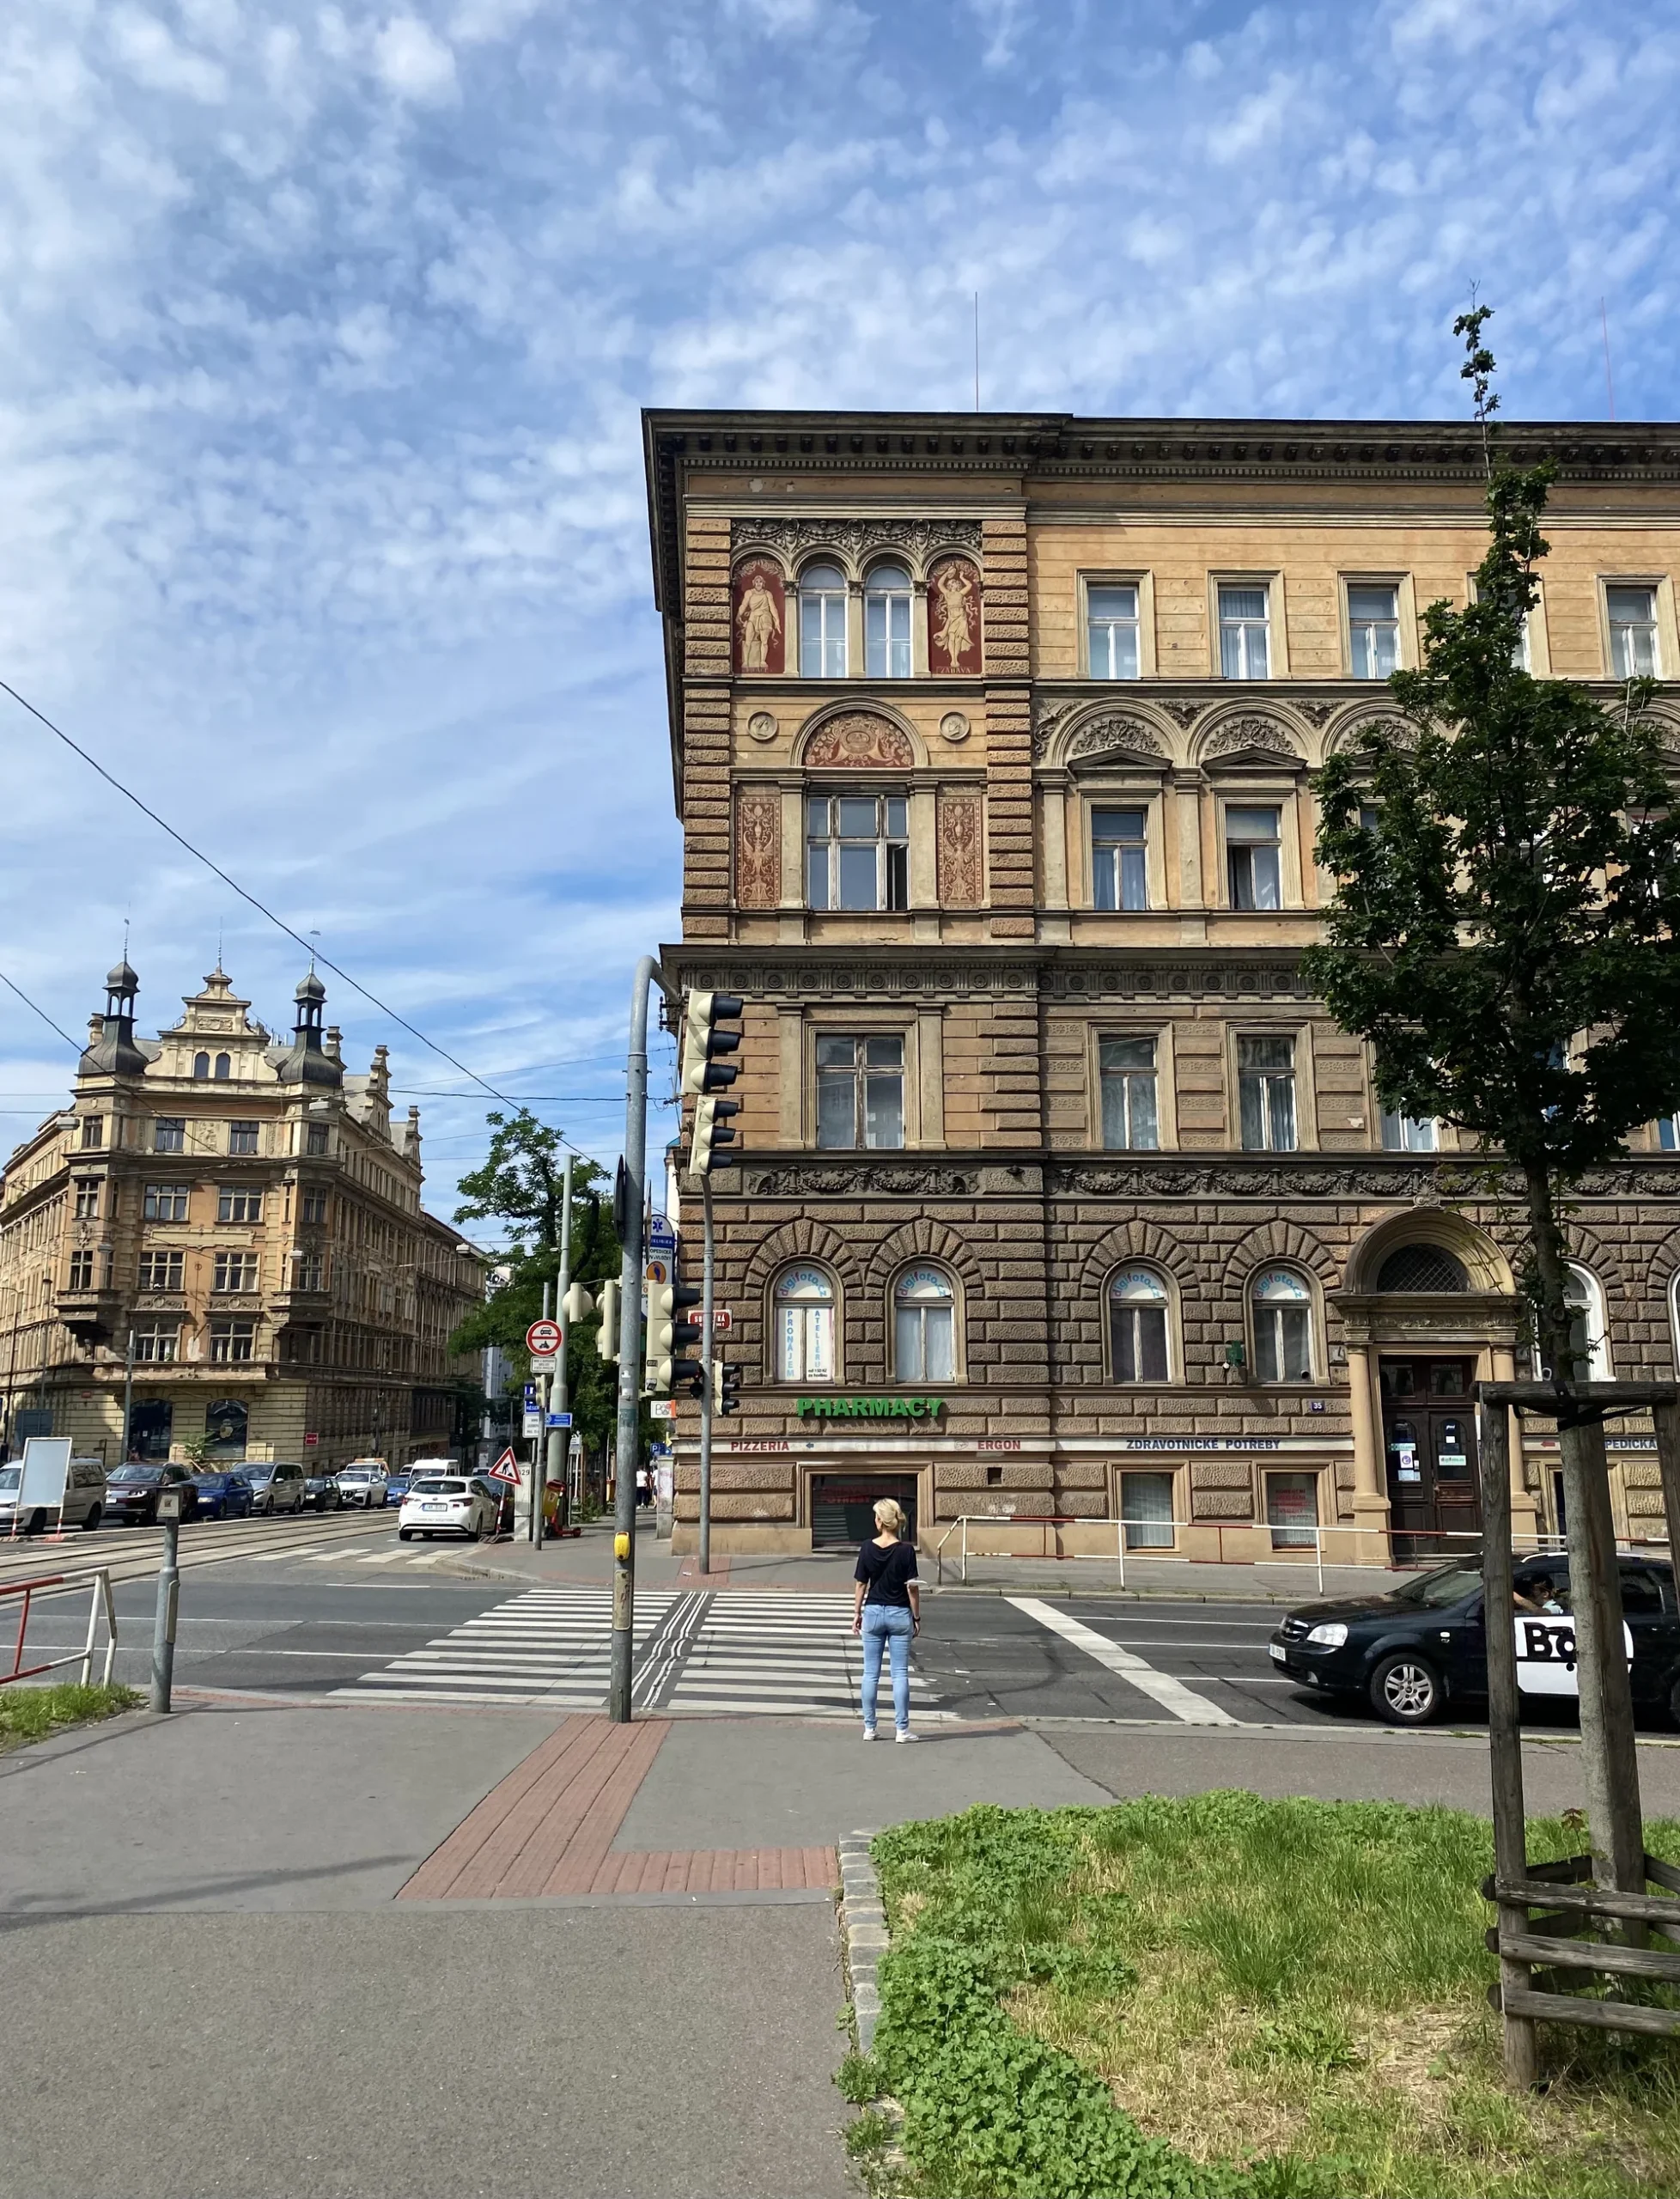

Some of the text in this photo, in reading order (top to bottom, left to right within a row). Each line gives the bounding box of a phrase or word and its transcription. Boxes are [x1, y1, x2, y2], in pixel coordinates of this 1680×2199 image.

[780, 1271, 827, 1297] digifoto.cz
[898, 1271, 947, 1297] digifoto.cz
[1112, 1272, 1160, 1299] digifoto.cz
[1255, 1273, 1302, 1299] digifoto.cz
[796, 1397, 943, 1416] PHARMACY
[731, 1441, 789, 1451] PIZZERIA
[977, 1440, 1021, 1450] ERGON
[1126, 1437, 1281, 1449] ZDRAVOTNICKÉ POTŘEBY
[1604, 1437, 1657, 1449] PEDICKÁ
